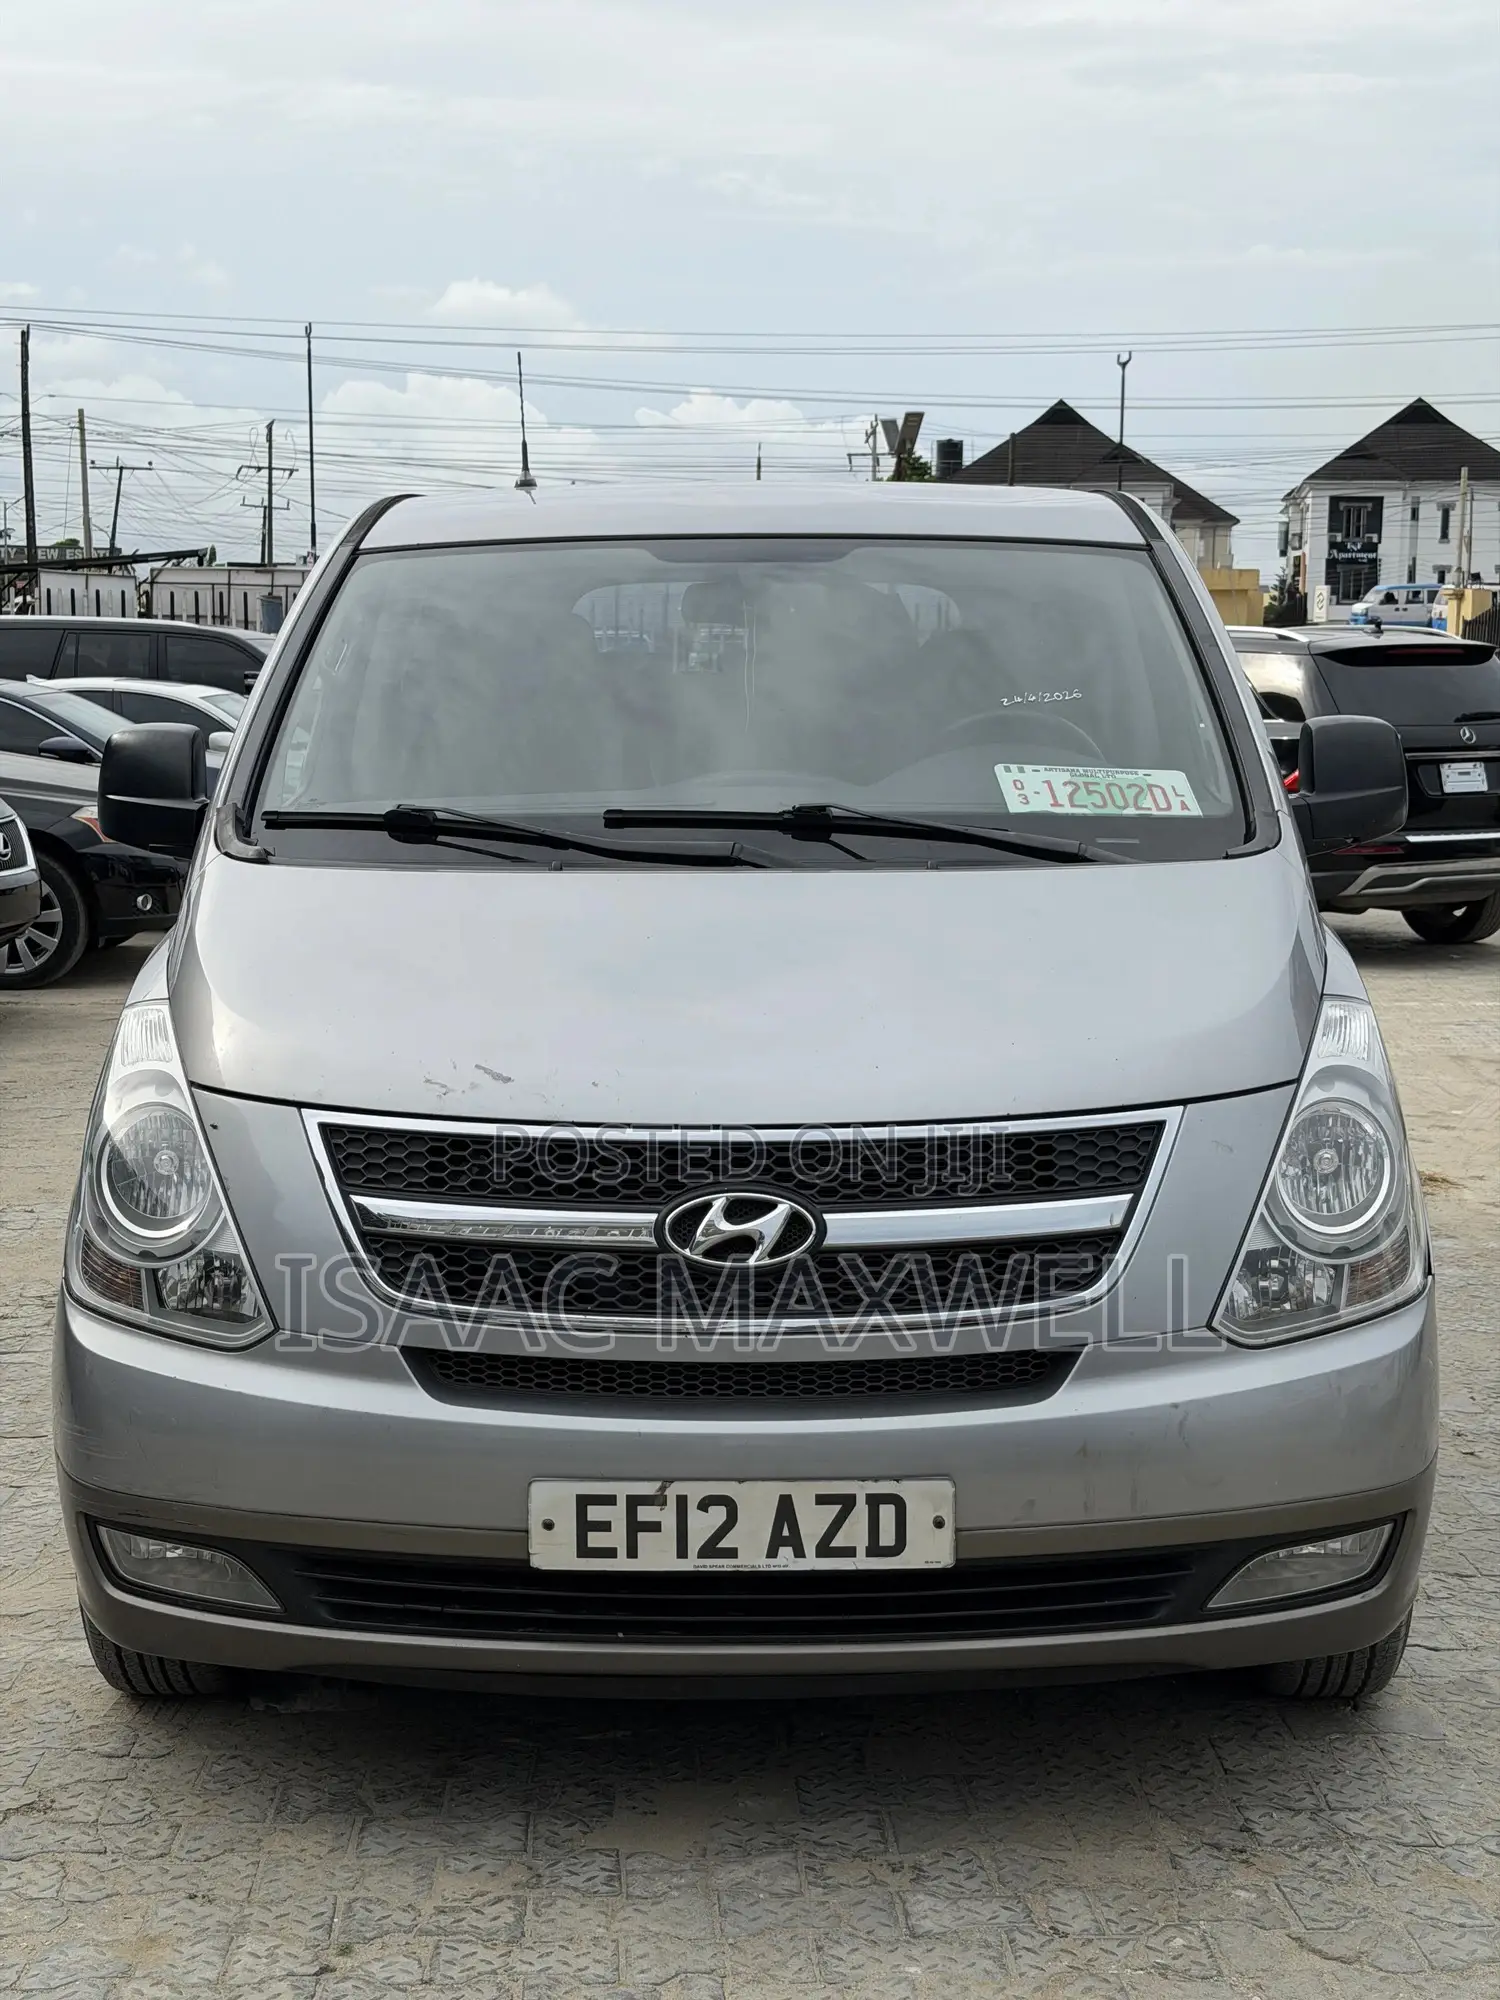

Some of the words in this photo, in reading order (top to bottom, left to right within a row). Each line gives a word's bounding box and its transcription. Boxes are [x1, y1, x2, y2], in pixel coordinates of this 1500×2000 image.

[1000, 688, 1082, 706] 24/4/2026
[575, 1493, 739, 1560] EF12
[765, 1492, 907, 1560] AZD
